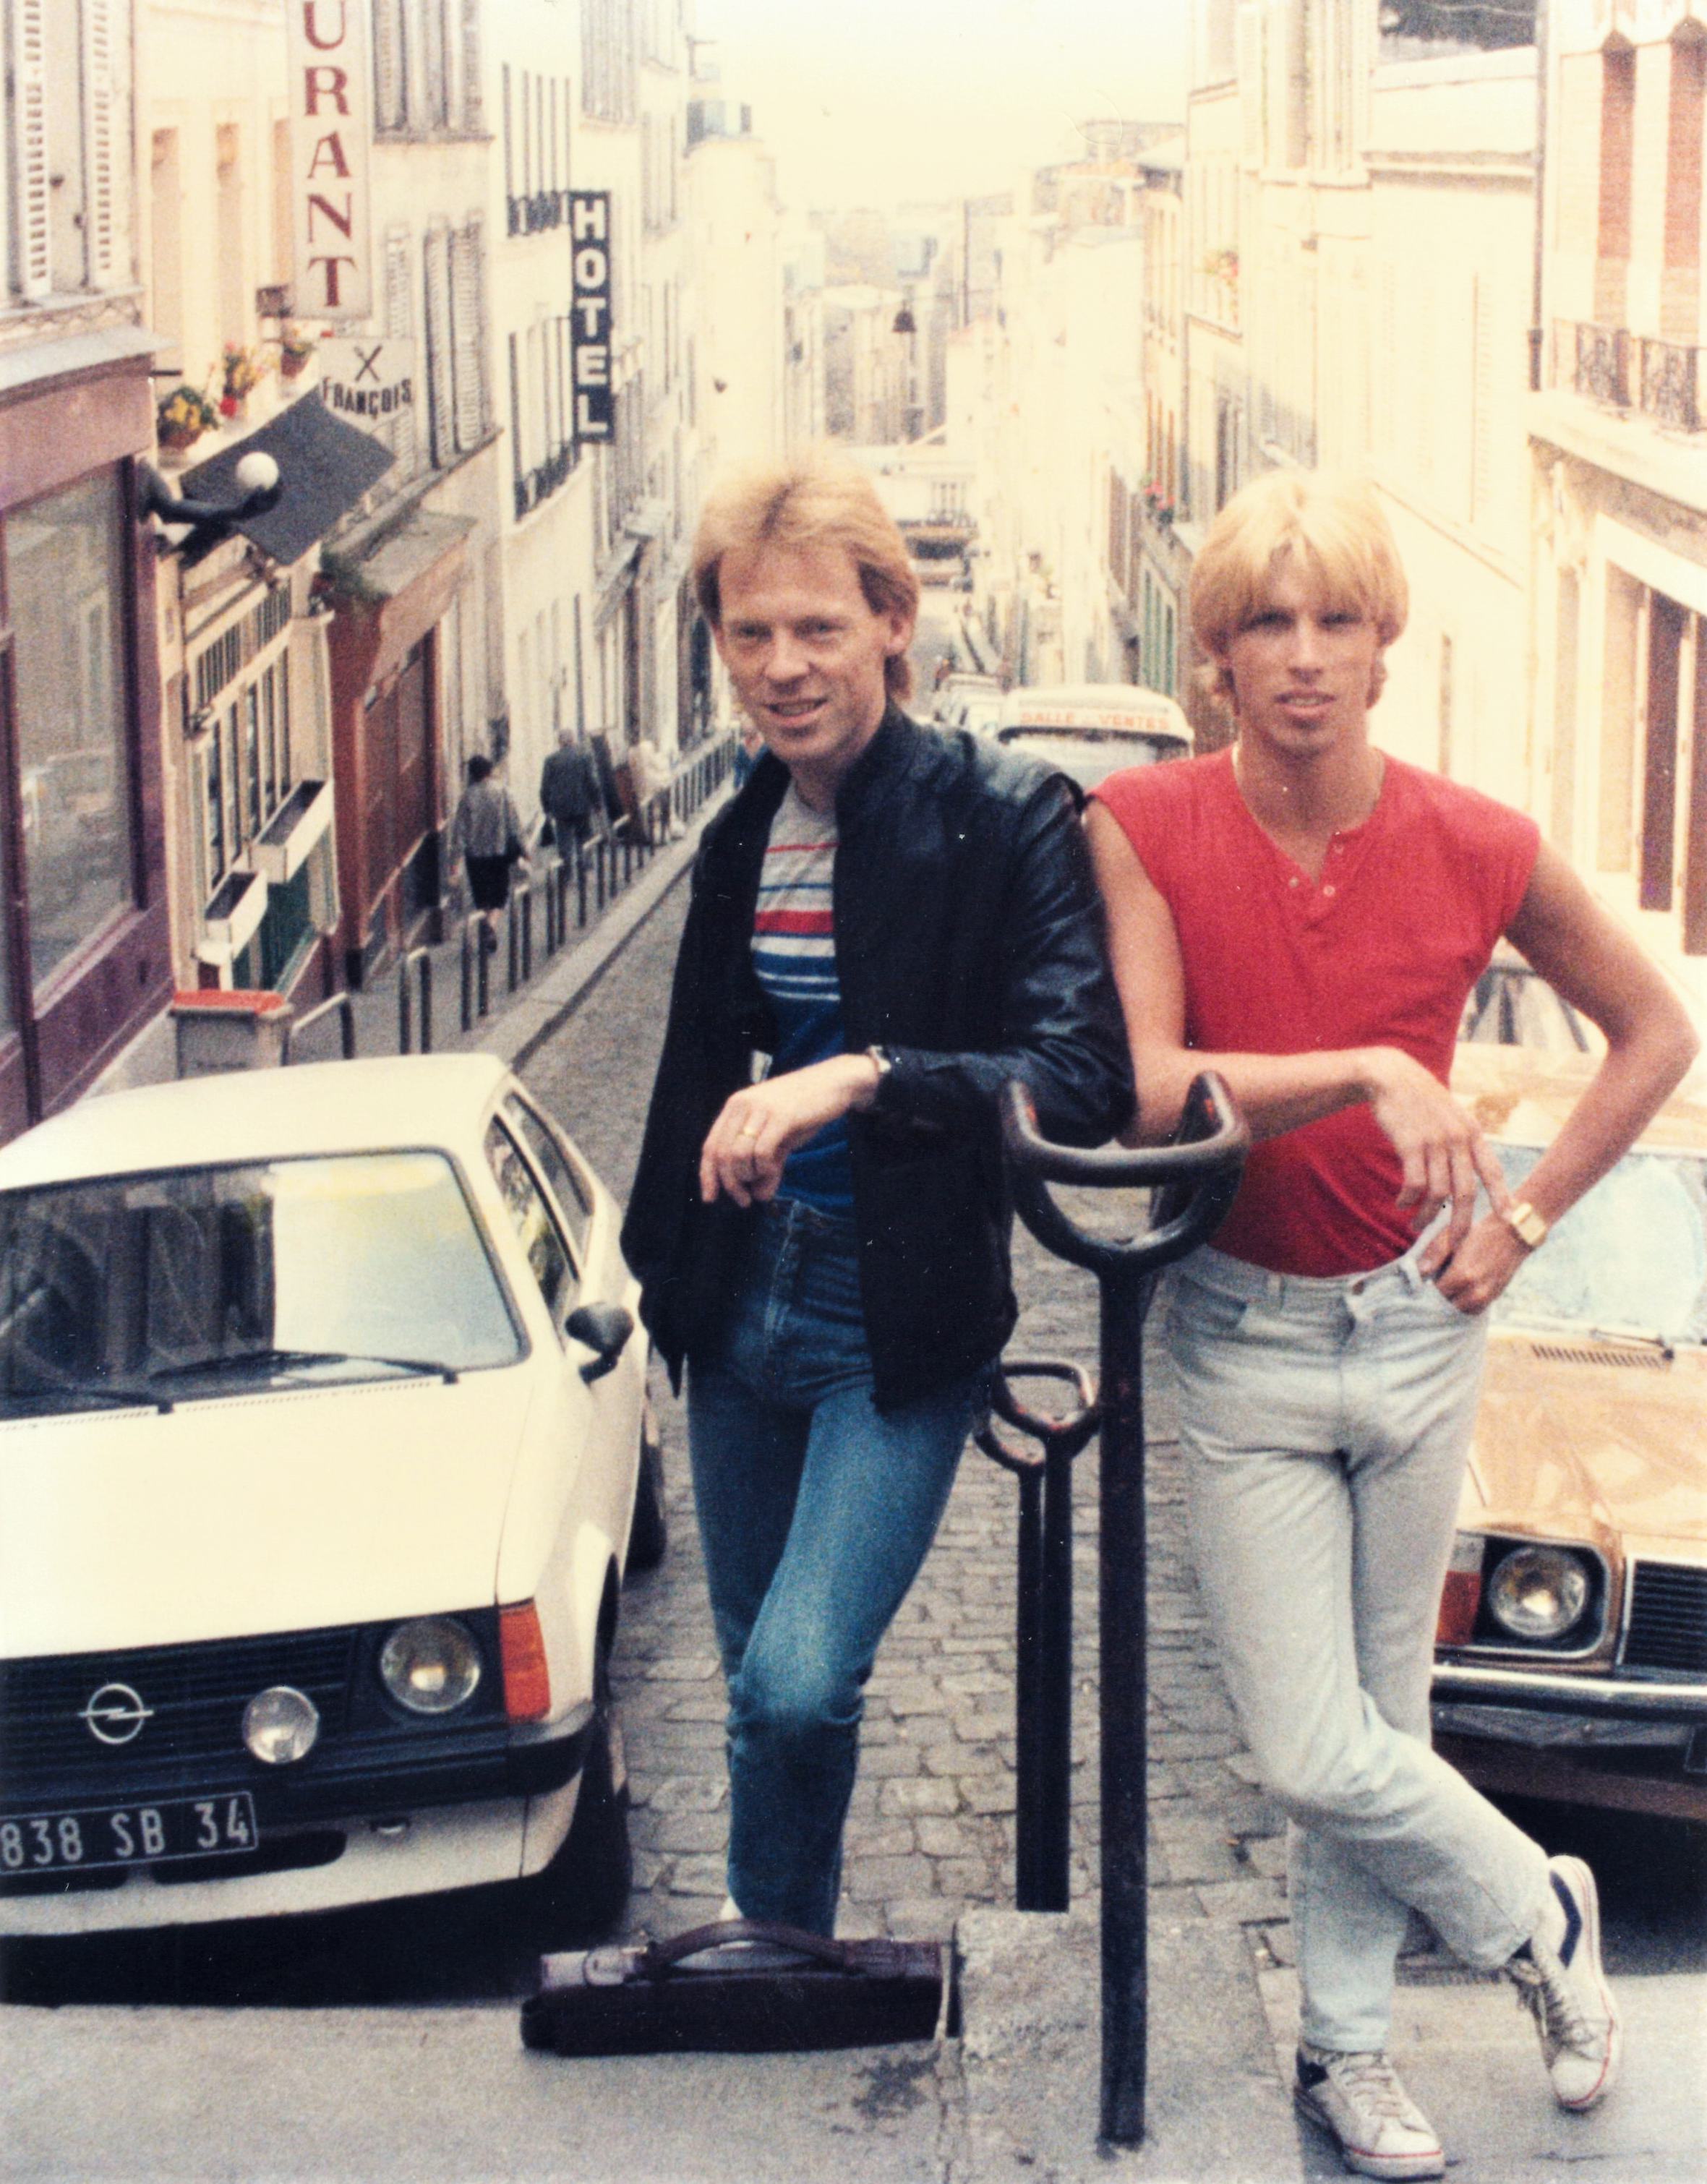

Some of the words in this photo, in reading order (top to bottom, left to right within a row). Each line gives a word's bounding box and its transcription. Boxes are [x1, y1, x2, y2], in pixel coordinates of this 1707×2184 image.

[302, 0, 356, 307] URANT
[574, 199, 609, 433] HOTEL
[322, 376, 411, 420] FRANÇOIS
[0, 1817, 83, 1867] 838
[110, 1808, 166, 1858] SB
[194, 1798, 249, 1849] 34
